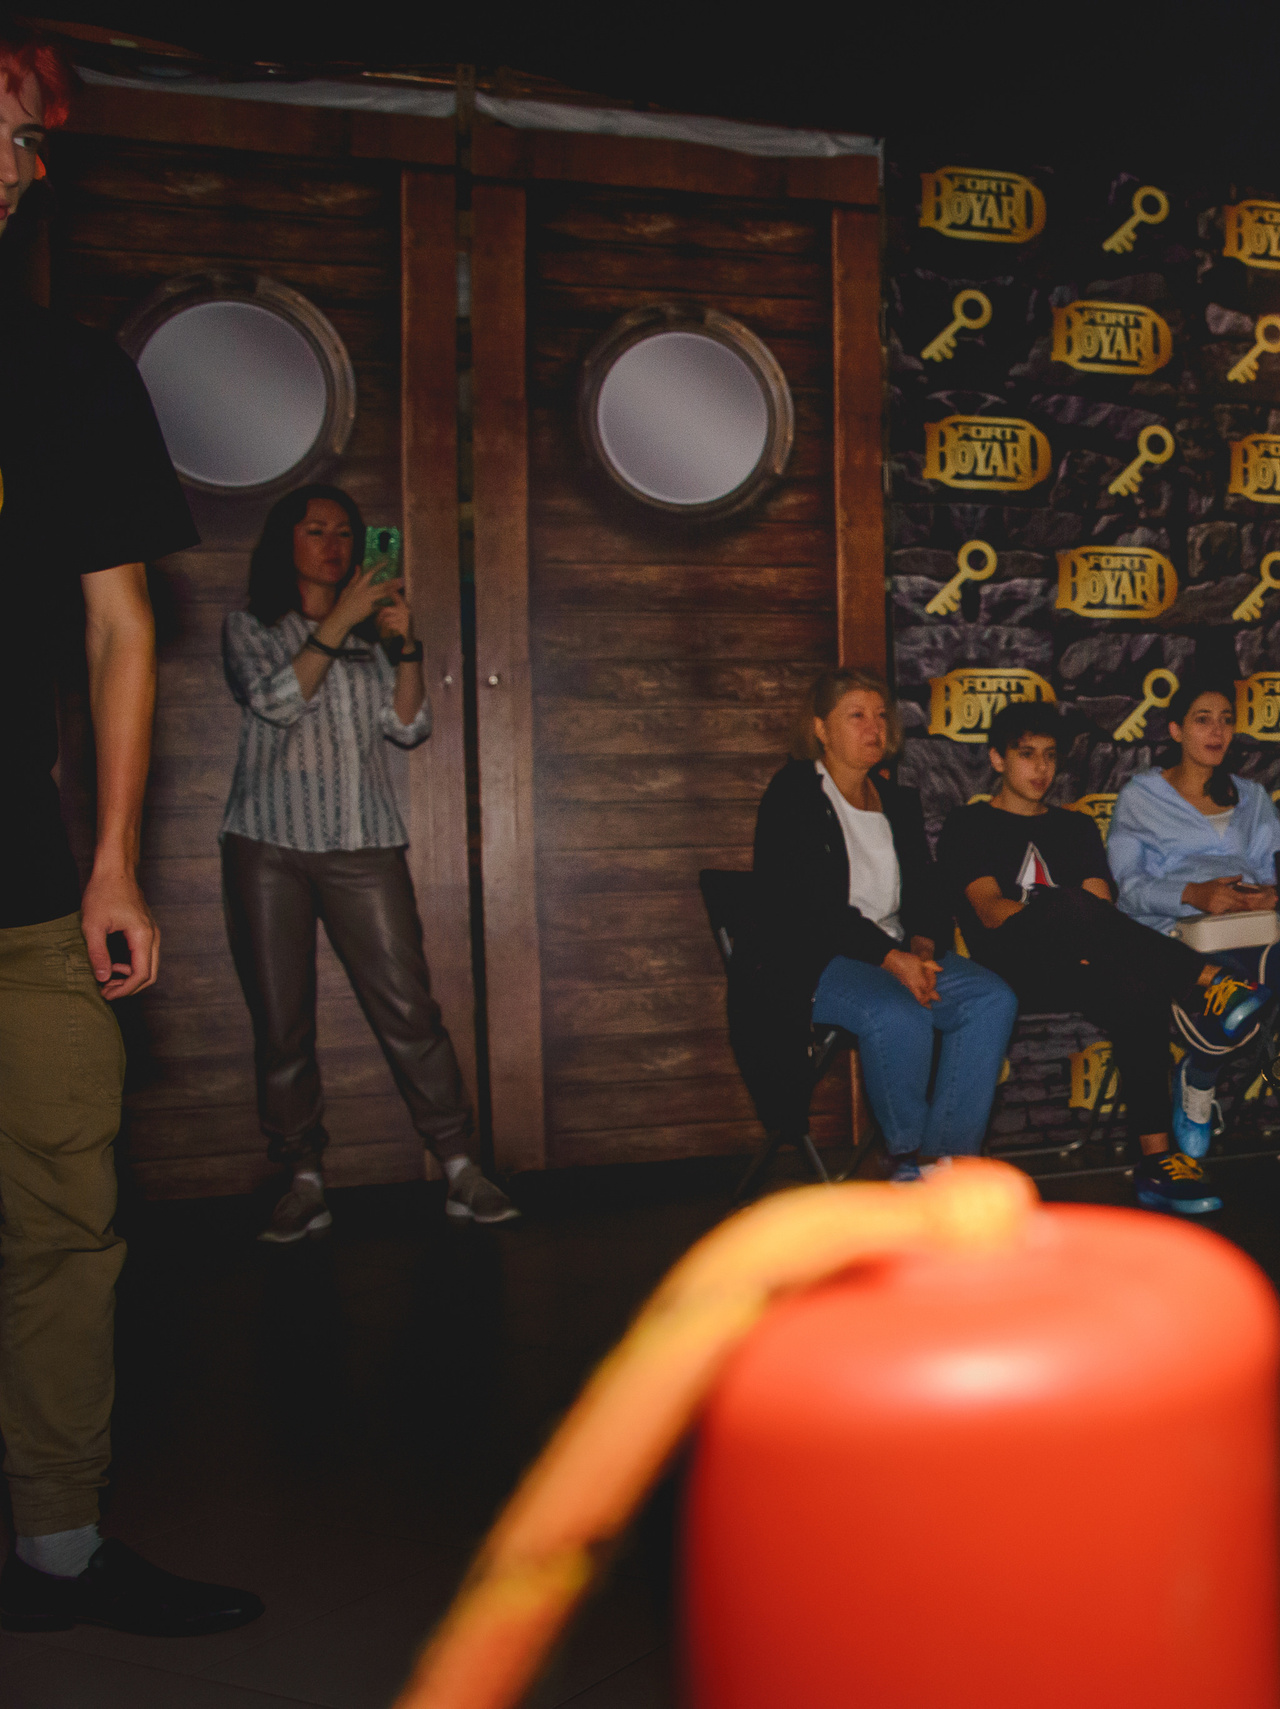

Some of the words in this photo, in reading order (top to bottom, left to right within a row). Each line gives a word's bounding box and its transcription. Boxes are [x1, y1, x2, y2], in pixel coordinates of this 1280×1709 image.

[919, 166, 1047, 243] BOYARD
[953, 176, 1011, 193] FORT
[1051, 301, 1173, 375] BOYARD
[1081, 310, 1144, 327] FORT
[923, 415, 1052, 490] BOYARD
[956, 426, 1013, 441] FORT
[1055, 546, 1179, 619] BOYARD
[1086, 555, 1147, 571] FORT
[928, 668, 1057, 743] BOY
[961, 678, 1018, 693] FORT
